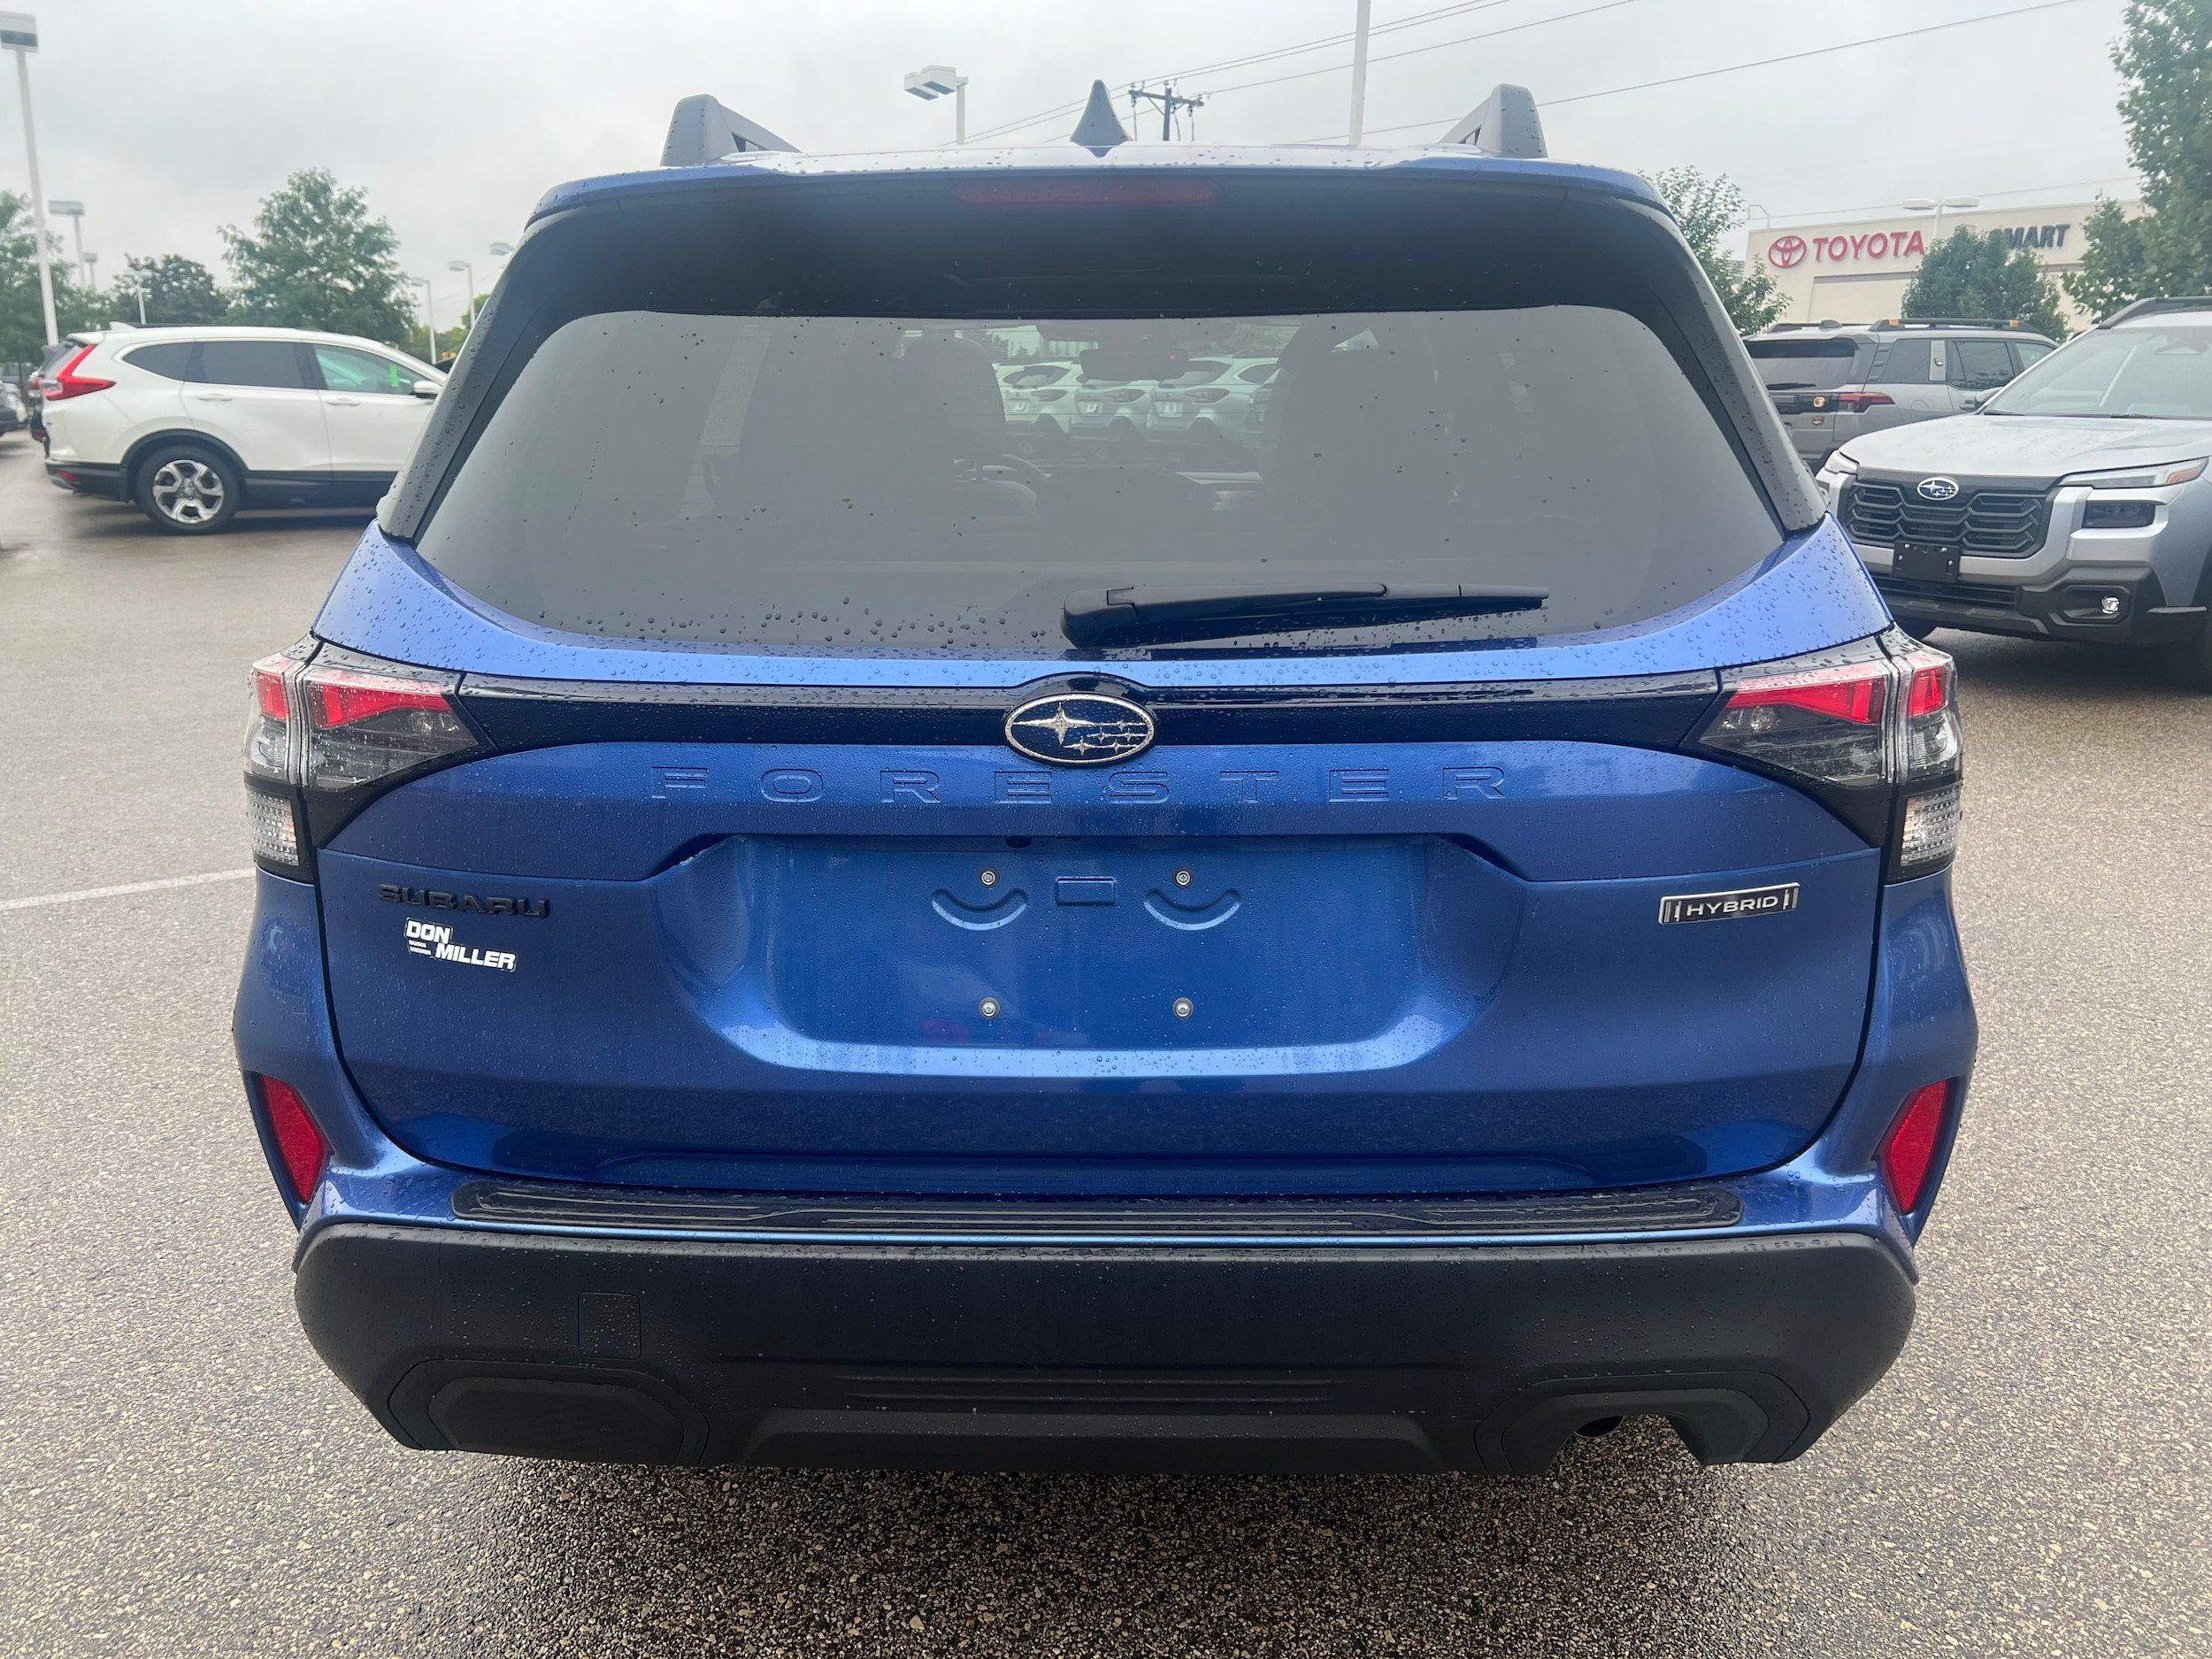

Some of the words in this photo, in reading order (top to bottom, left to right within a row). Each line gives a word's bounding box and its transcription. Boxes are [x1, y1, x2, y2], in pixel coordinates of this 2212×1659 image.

[1812, 230, 1925, 263] TOYOTA
[1988, 223, 2070, 249] MART
[651, 766, 1505, 804] FORESTER
[378, 884, 550, 919] SUBARU
[1686, 896, 1779, 916] HYBRID
[405, 920, 451, 944] DON
[434, 943, 516, 970] MILLER
